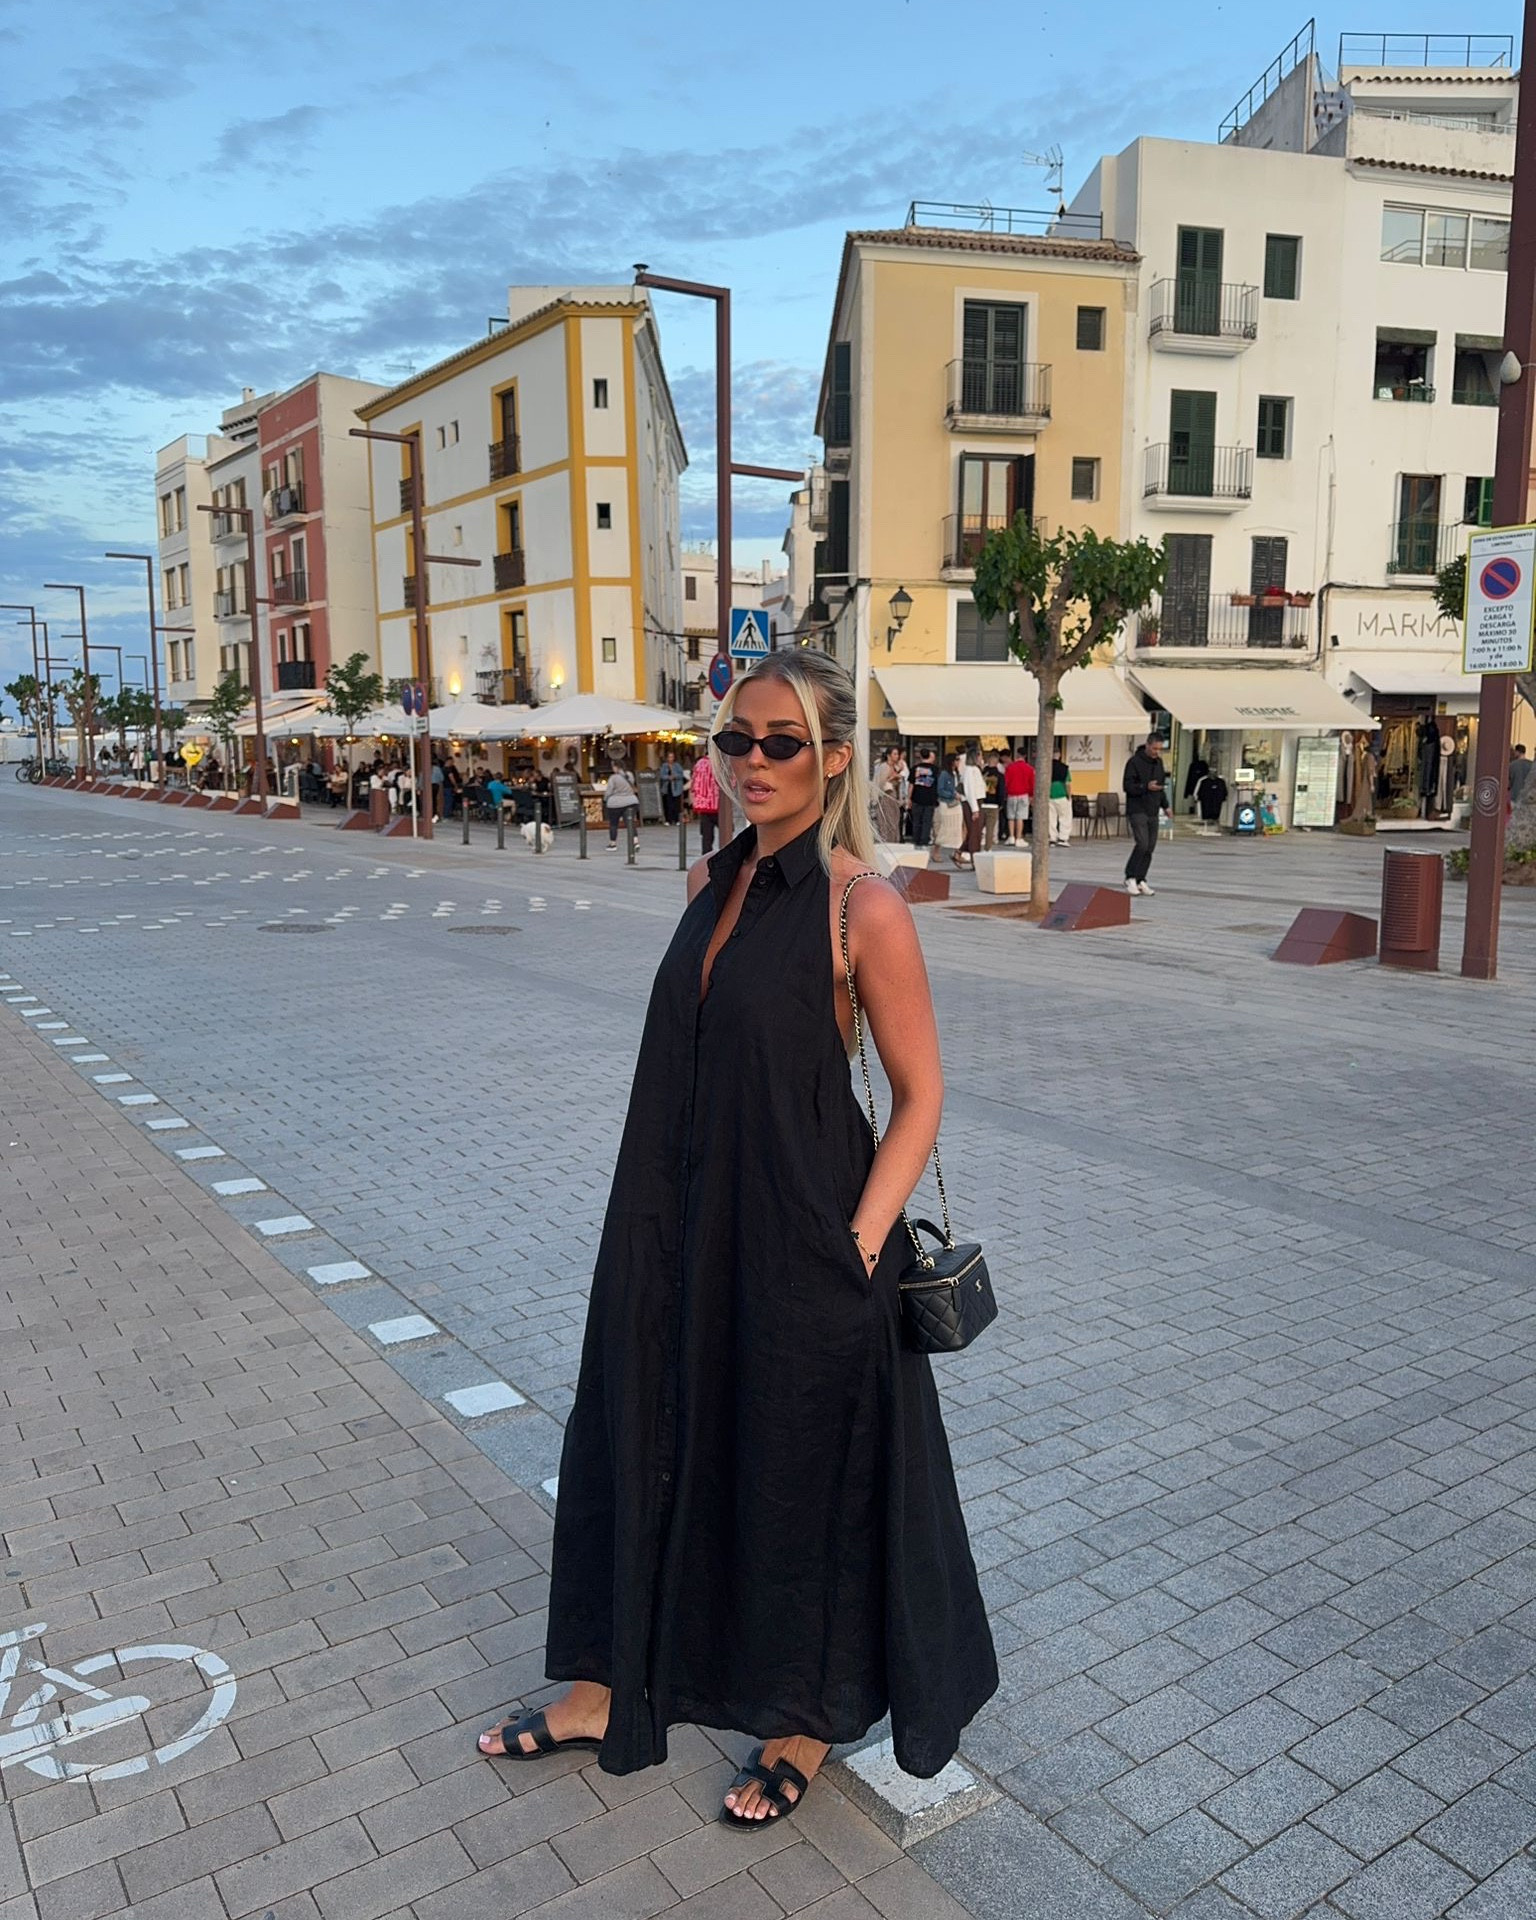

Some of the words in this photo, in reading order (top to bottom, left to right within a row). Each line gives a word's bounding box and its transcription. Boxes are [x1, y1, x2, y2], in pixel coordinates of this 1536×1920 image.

[1483, 605, 1514, 613] EXCEPTO
[1483, 613, 1507, 621] CARGA
[1480, 620, 1516, 629] DESCARGA
[1481, 637, 1513, 645] MINUTOS
